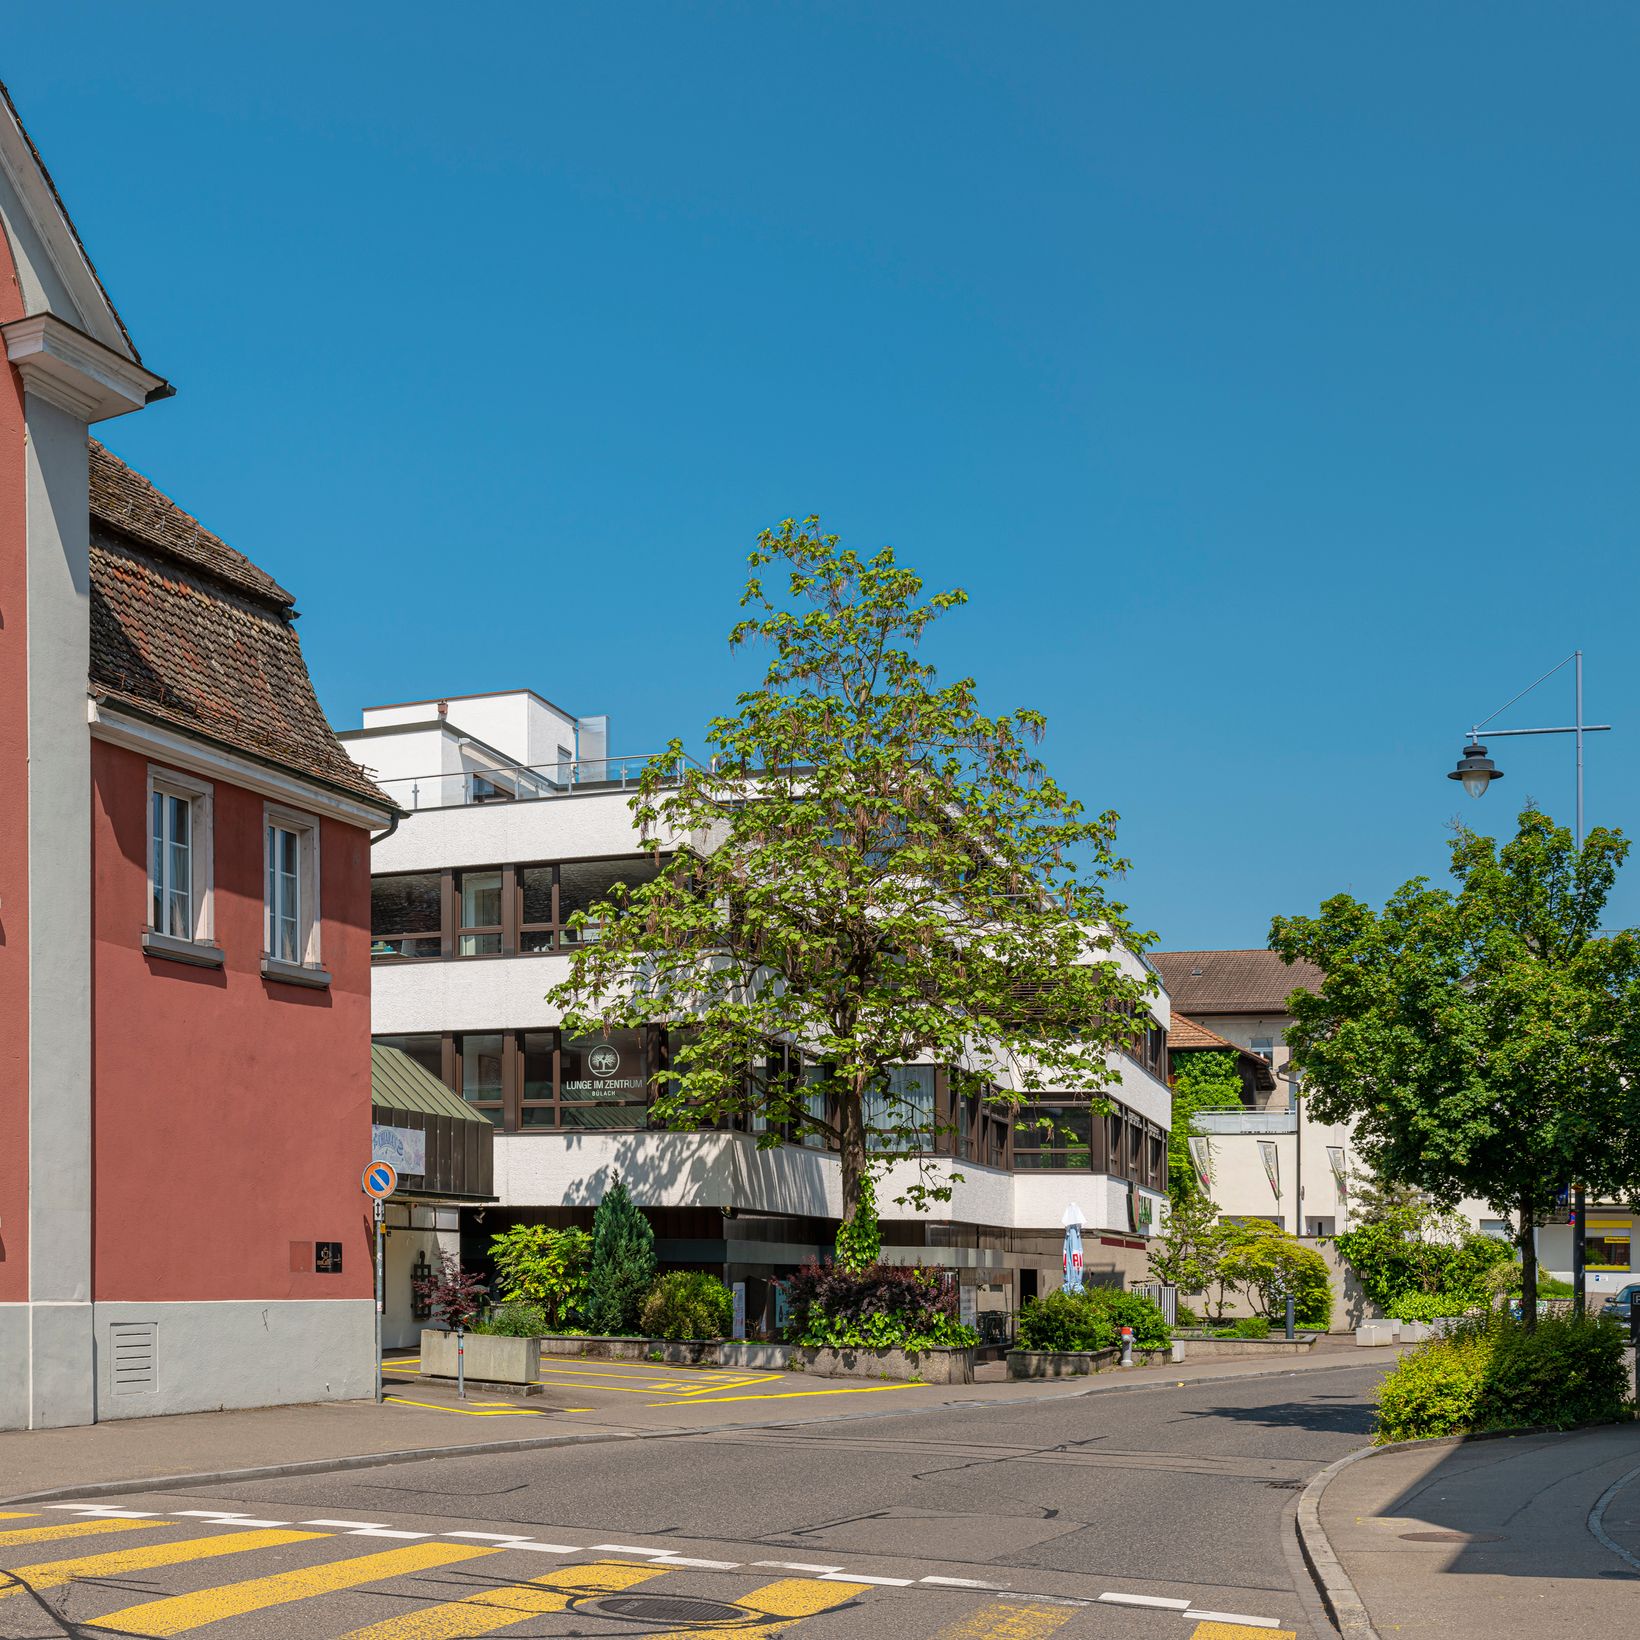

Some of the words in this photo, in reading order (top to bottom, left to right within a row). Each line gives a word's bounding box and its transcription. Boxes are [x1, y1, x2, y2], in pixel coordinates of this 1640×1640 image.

[566, 1080, 592, 1090] LUNGE
[593, 1080, 604, 1089] IM
[604, 1079, 643, 1089] ZENTRUM
